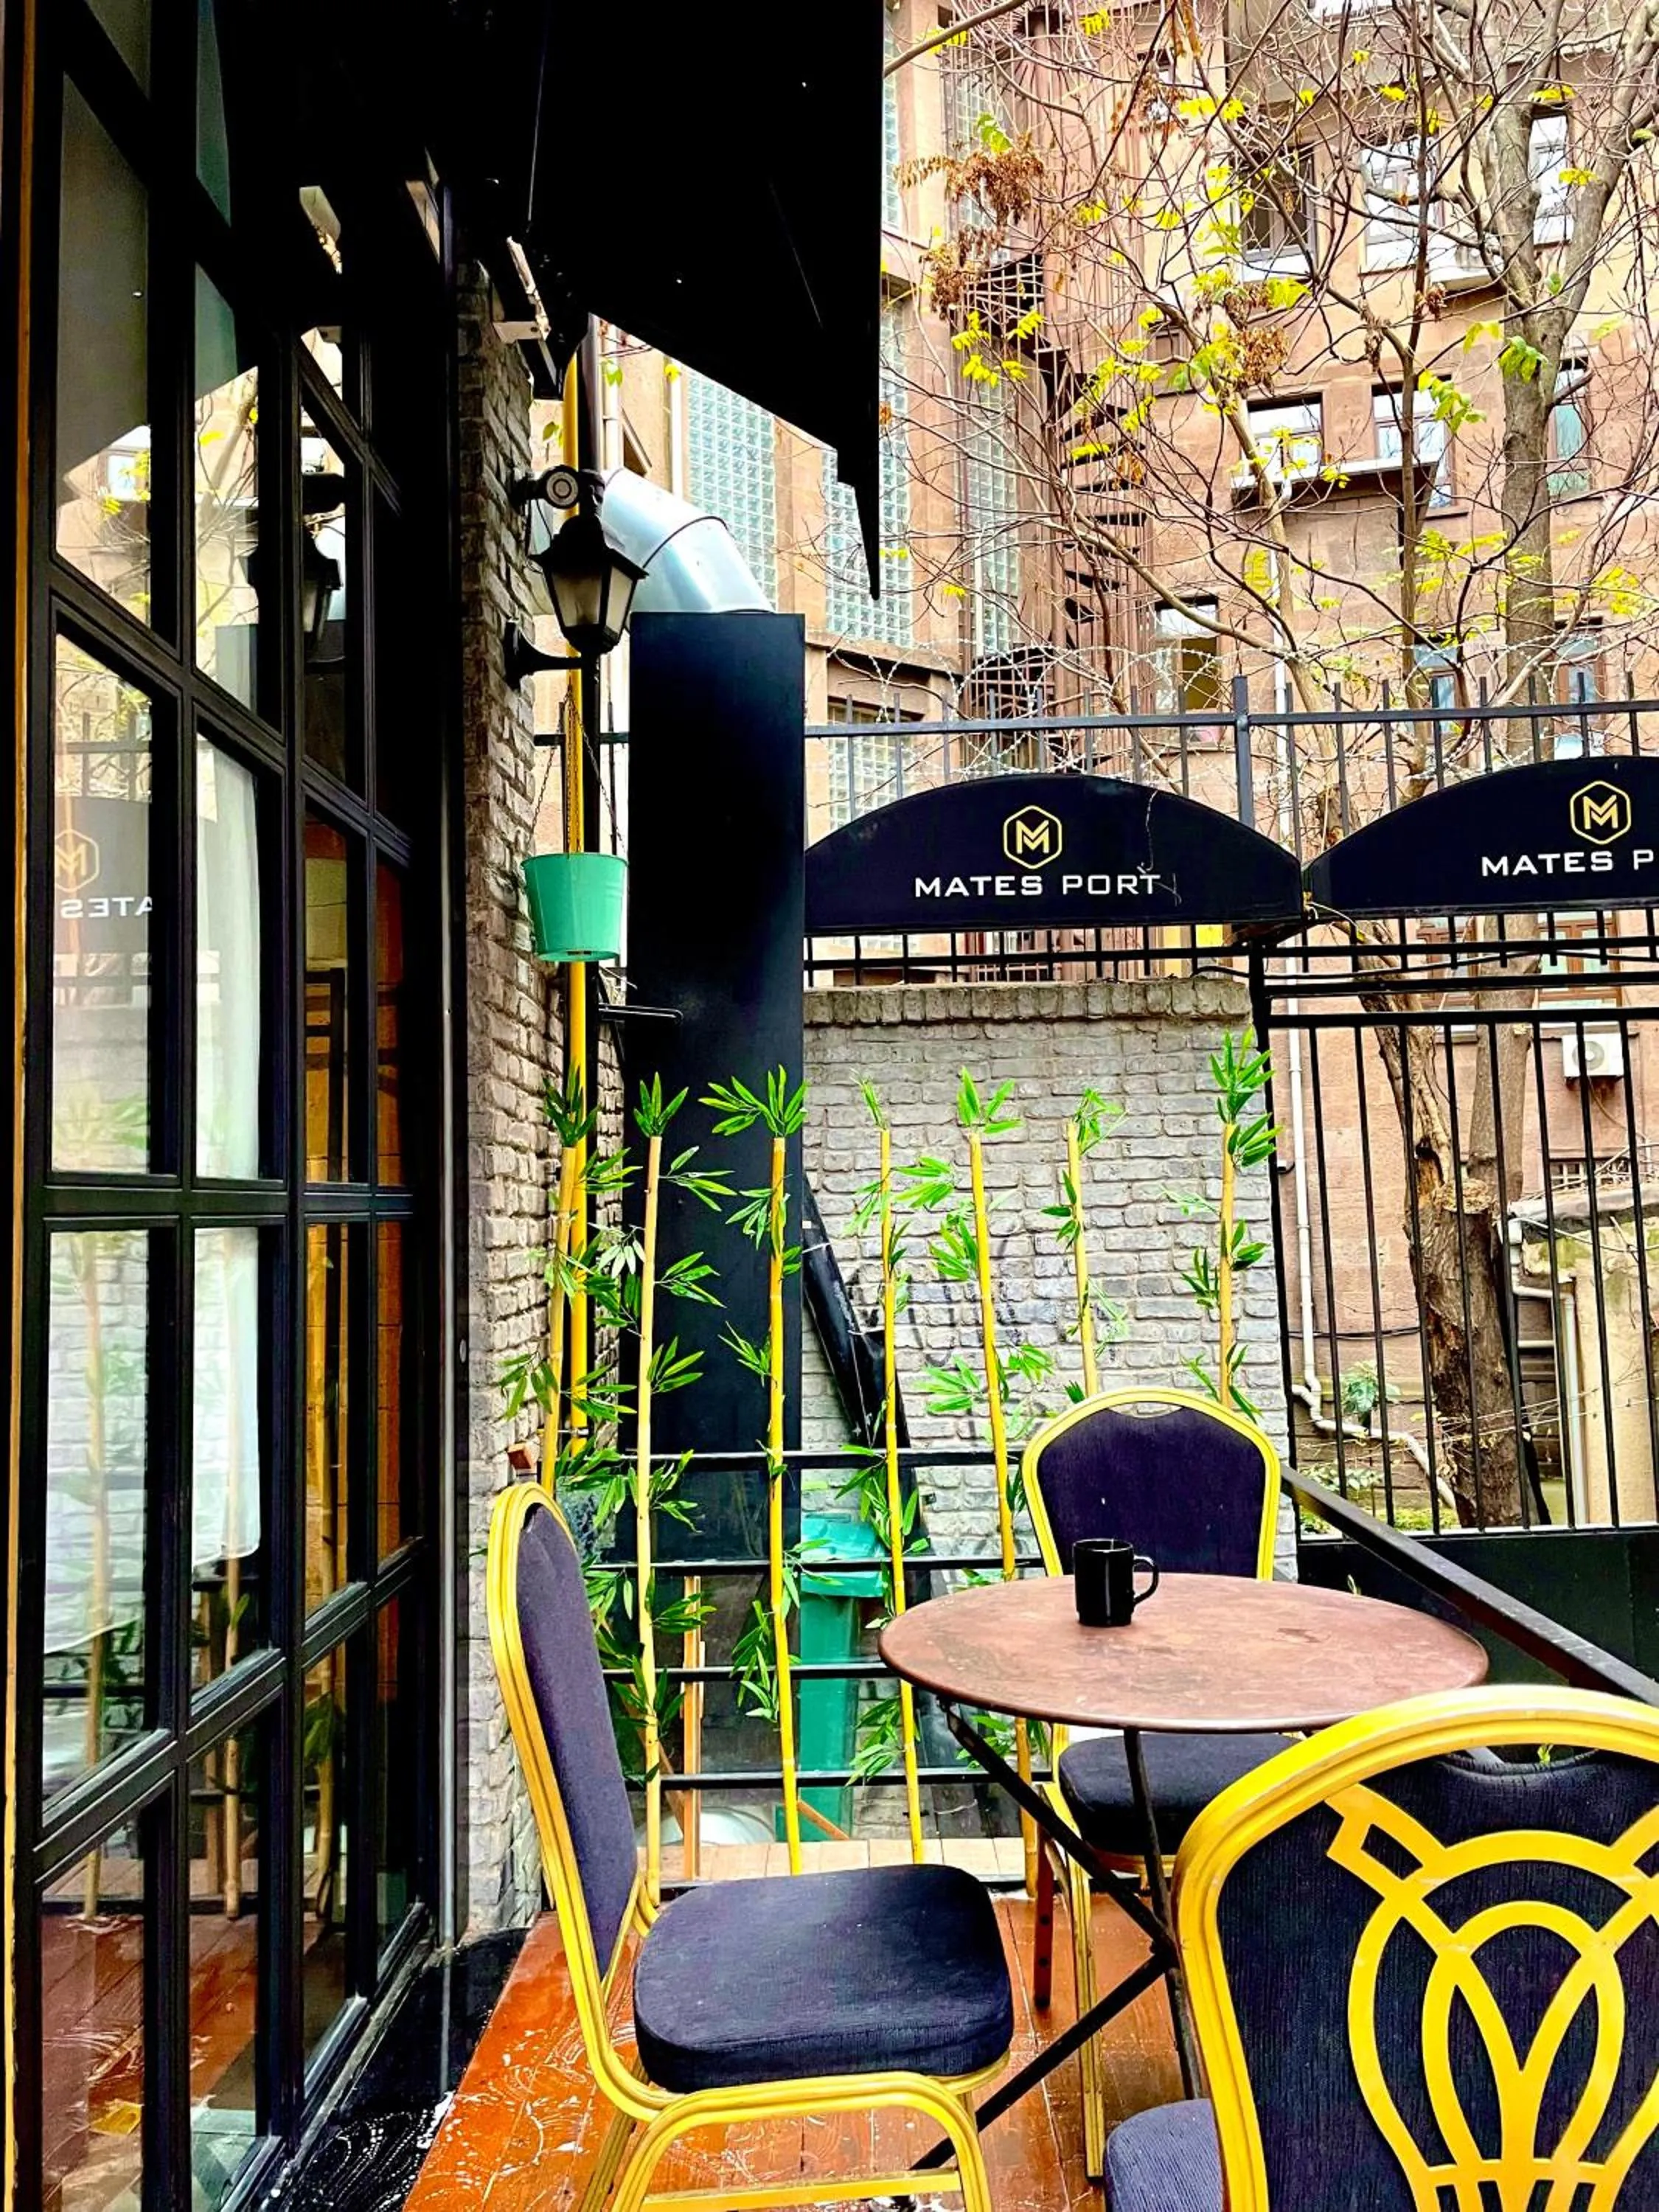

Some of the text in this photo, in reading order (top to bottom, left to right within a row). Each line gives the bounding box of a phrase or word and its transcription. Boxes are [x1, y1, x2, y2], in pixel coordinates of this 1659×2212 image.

[1481, 849, 1654, 876] MATES P
[915, 874, 1161, 897] MATES PORT
